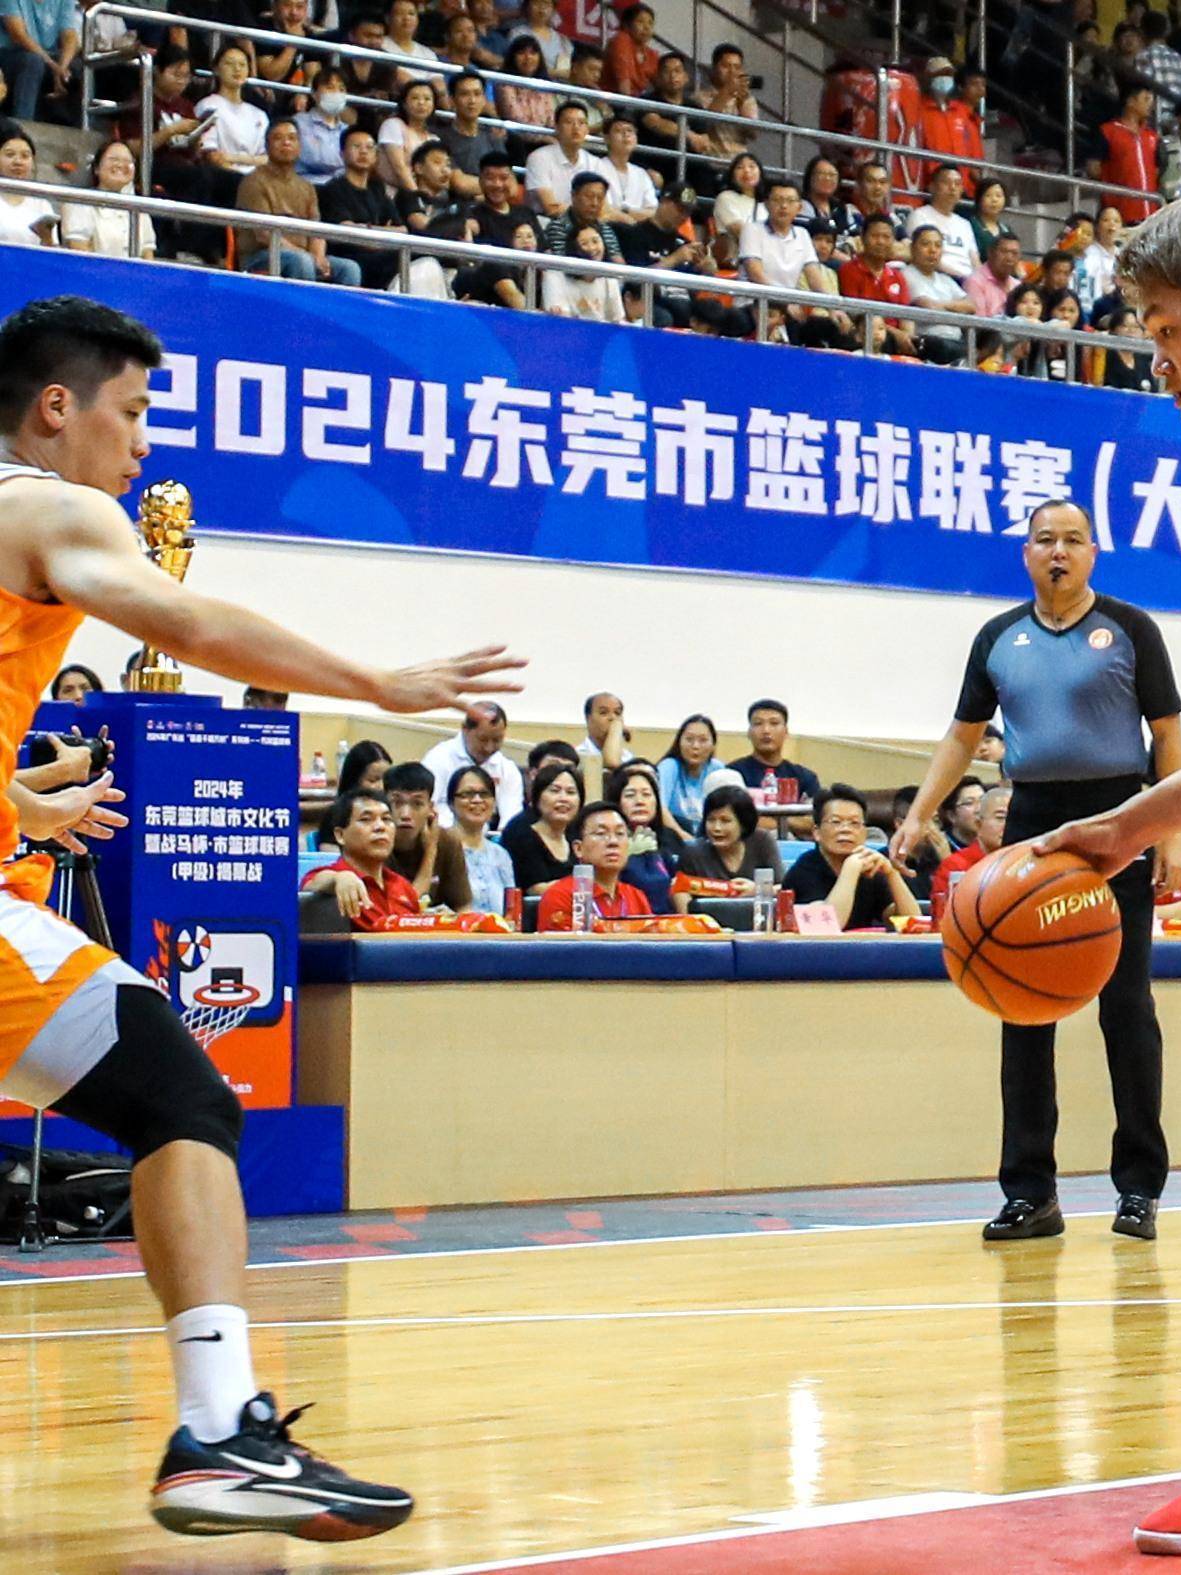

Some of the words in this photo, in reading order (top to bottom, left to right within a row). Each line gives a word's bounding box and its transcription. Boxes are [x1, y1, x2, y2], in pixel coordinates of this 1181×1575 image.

[193, 779, 244, 800] 2024年
[145, 804, 291, 829] 东莞篮球城市文化节
